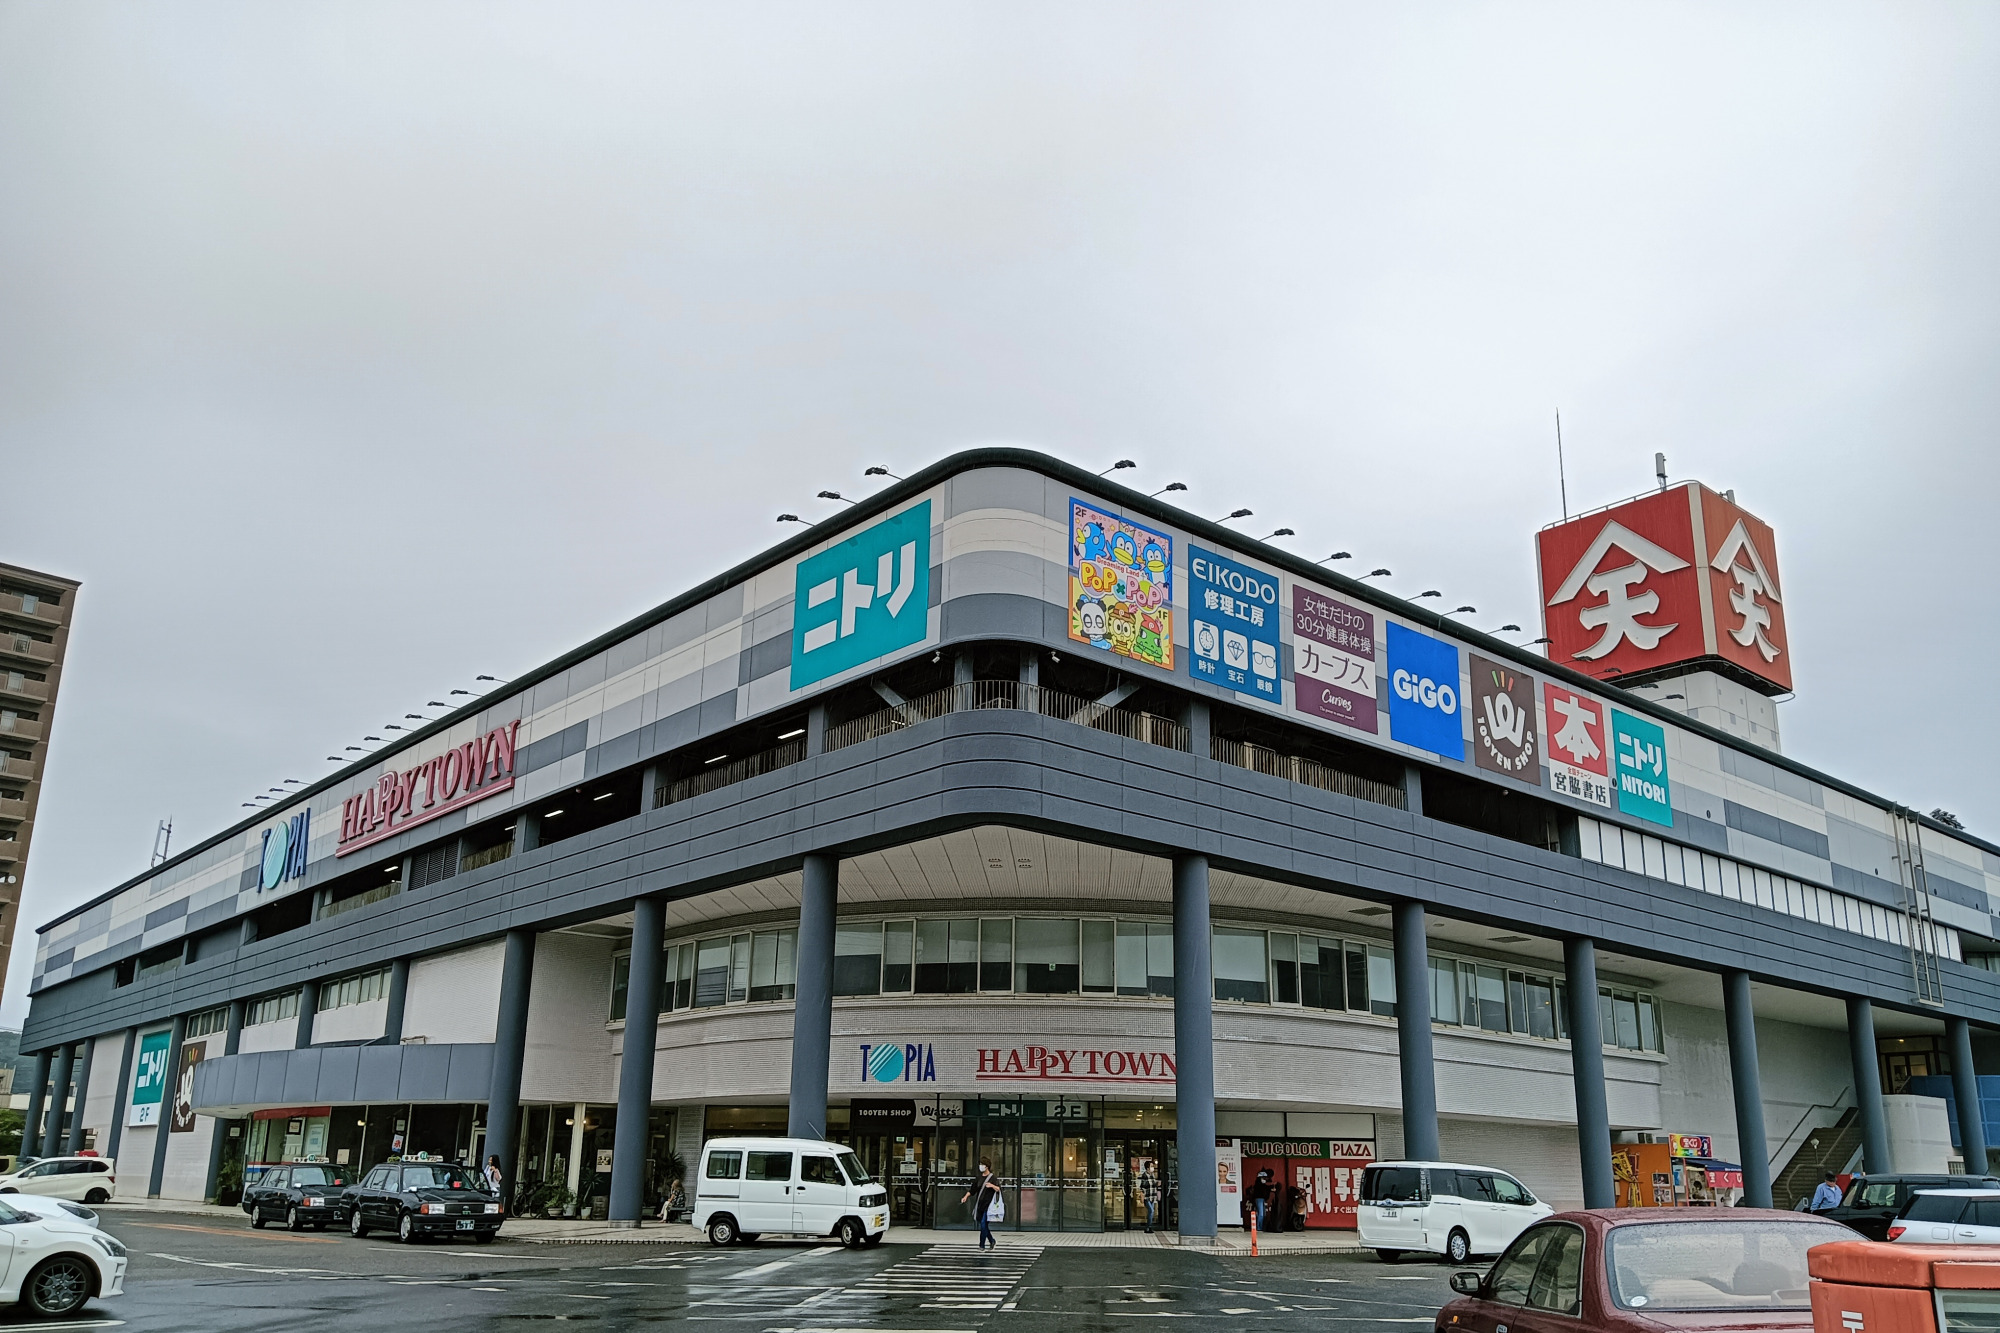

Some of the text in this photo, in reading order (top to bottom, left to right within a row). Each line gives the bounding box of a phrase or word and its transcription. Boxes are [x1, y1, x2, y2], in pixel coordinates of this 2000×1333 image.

[1075, 506, 1087, 518] 2F
[1096, 556, 1140, 578] Dreaming Land
[1192, 558, 1276, 605] EIKODO
[803, 540, 916, 655] ニトリ
[1203, 588, 1265, 628] 修理工房
[1303, 596, 1365, 631] 女性だけの
[1158, 610, 1168, 620] 1F
[1296, 613, 1372, 655] 30分健康体操
[1198, 659, 1216, 675] 時計
[1227, 669, 1245, 685] 宝石
[1301, 644, 1370, 690] カーブス
[1256, 679, 1274, 694] 眼鏡
[1321, 689, 1353, 713] Curves
[1393, 668, 1457, 715] GiGO
[1477, 716, 1535, 771] 100YEN SHOP
[1553, 695, 1601, 765] 本
[1619, 732, 1663, 777] ニトリ
[338, 719, 522, 843] HAPPY TOWN
[1554, 772, 1606, 804] 宮脇書店
[1621, 773, 1667, 805] NITORI
[137, 1048, 167, 1088] ニトリ
[976, 1044, 1177, 1078] HAPPY TOWN
[139, 1106, 150, 1122] 2F
[890, 1109, 912, 1117] SHOP
[988, 1103, 1024, 1117] ニトリ
[1241, 1141, 1322, 1157] FUJICOLOR
[1332, 1143, 1372, 1157] PLAZA
